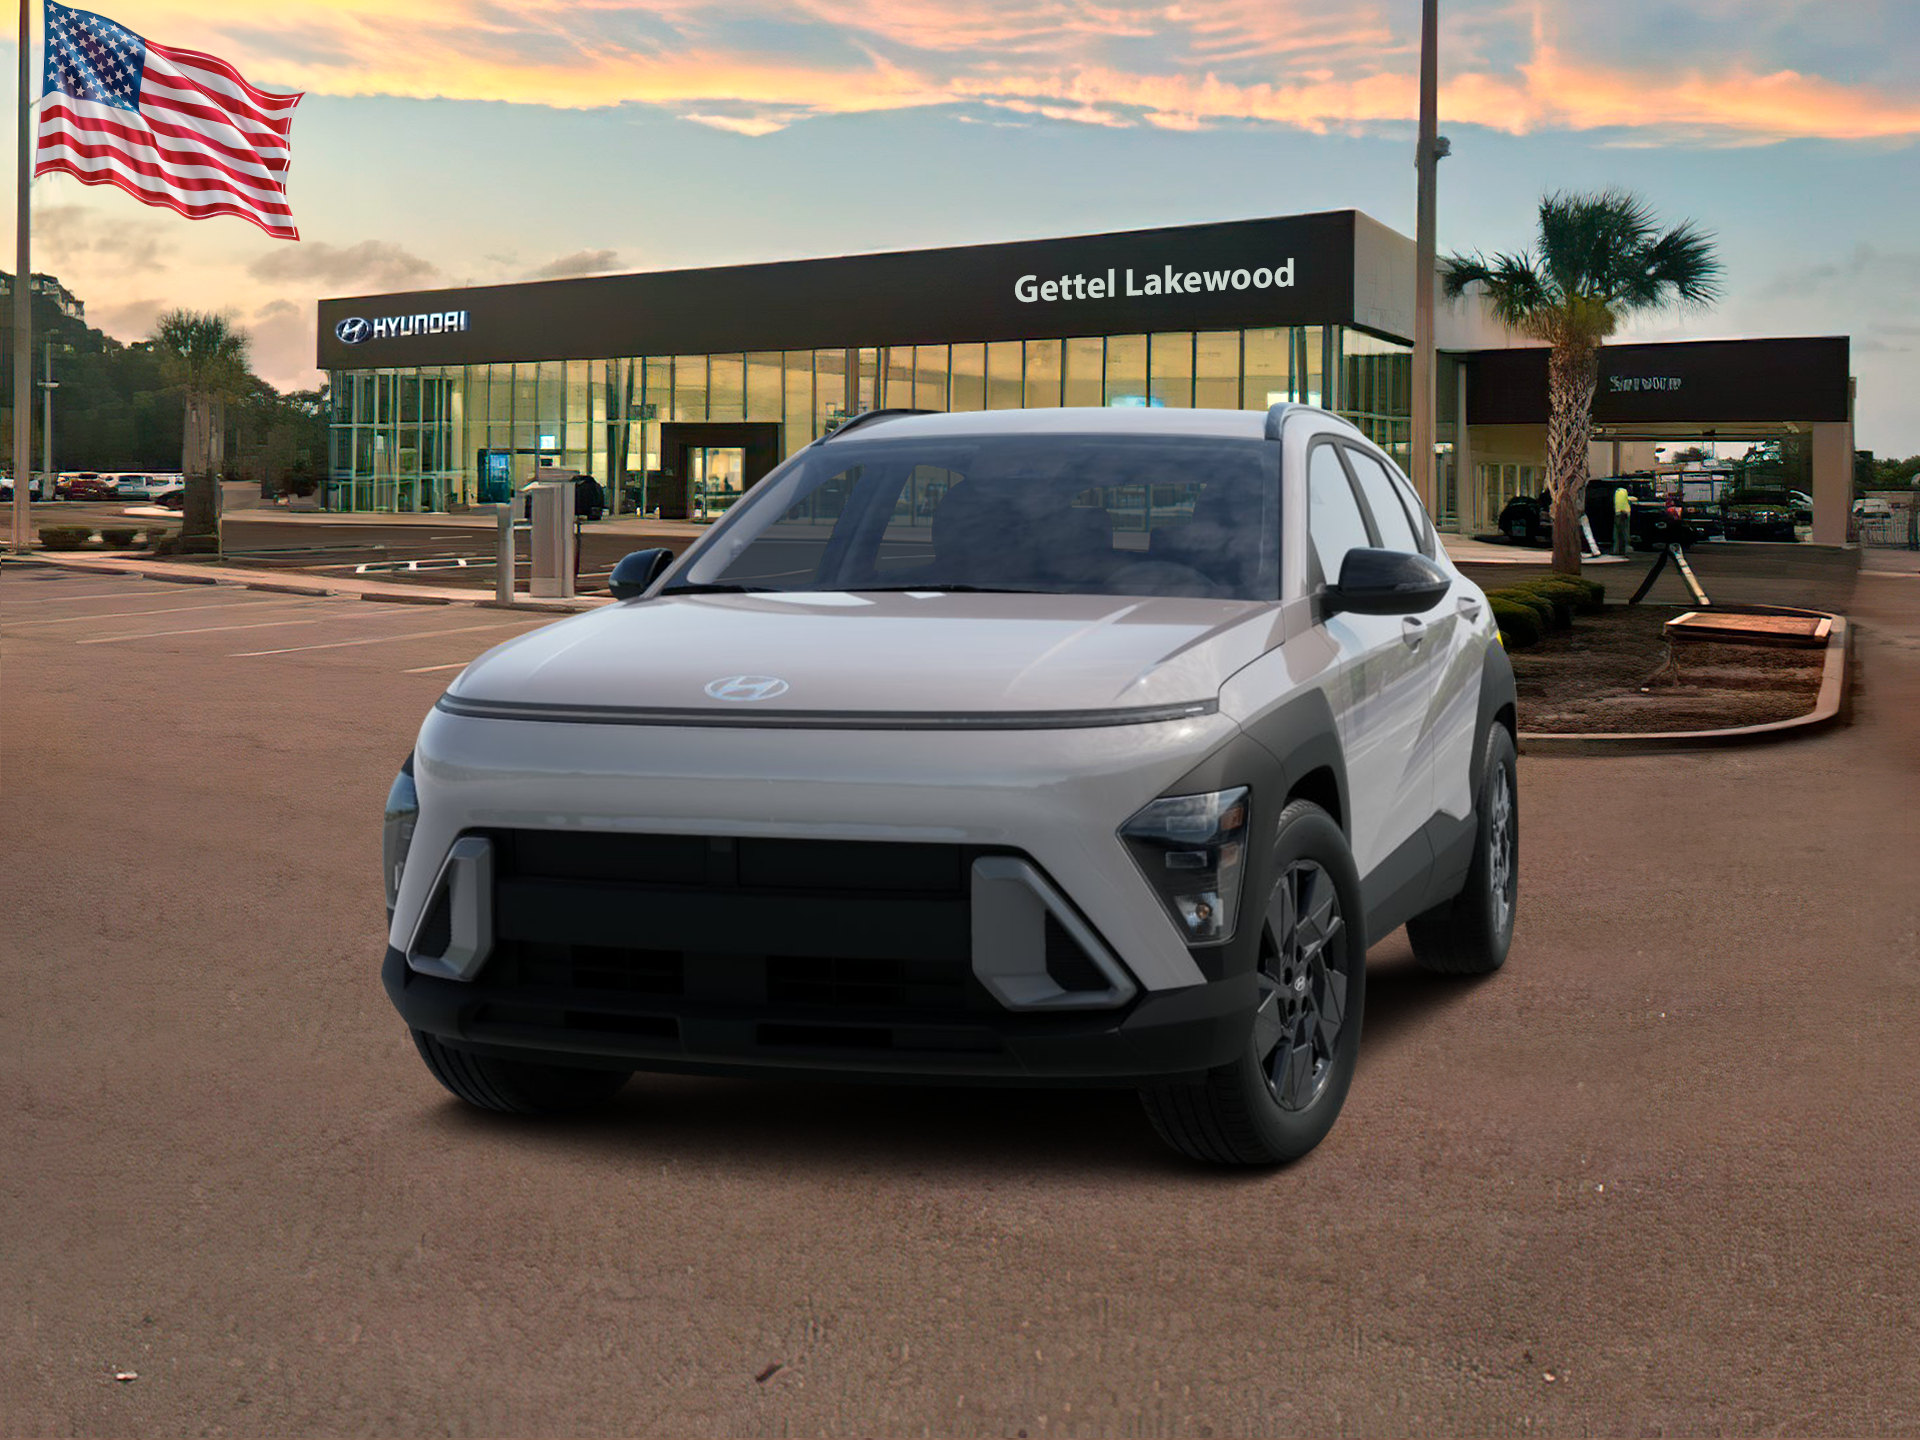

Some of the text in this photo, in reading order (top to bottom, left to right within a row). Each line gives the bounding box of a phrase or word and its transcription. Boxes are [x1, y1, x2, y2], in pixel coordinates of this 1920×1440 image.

[1014, 257, 1295, 303] Gettel Lakewood
[372, 310, 468, 339] HYUNDAI
